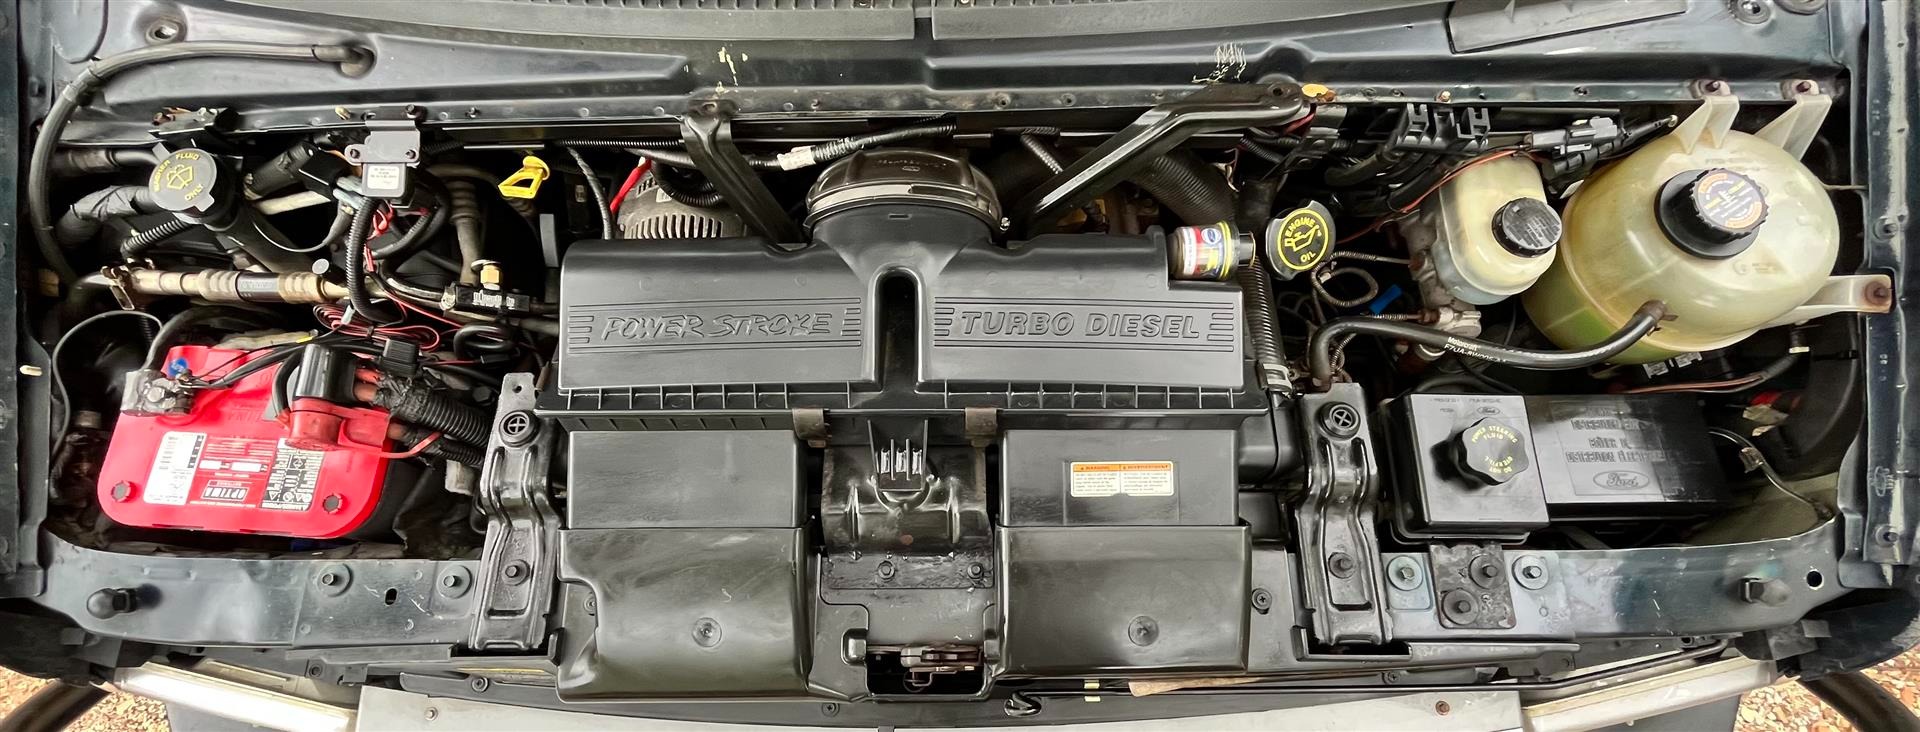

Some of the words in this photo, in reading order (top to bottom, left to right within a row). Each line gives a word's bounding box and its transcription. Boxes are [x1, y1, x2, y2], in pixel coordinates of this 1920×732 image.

[153, 159, 171, 193] WASHER
[175, 152, 201, 161] FLUID
[184, 183, 204, 201] ONLY
[1284, 216, 1317, 238] ENGINE
[1300, 251, 1317, 263] OIL
[600, 313, 705, 341] POWER
[707, 312, 833, 338] STROKE
[961, 311, 1075, 337] TURBO
[1085, 312, 1200, 339] DIESEL
[1471, 426, 1487, 443] POWER
[1488, 425, 1519, 443] STEERING
[1483, 432, 1504, 441] FLUID
[204, 487, 247, 500] OPTIMA
